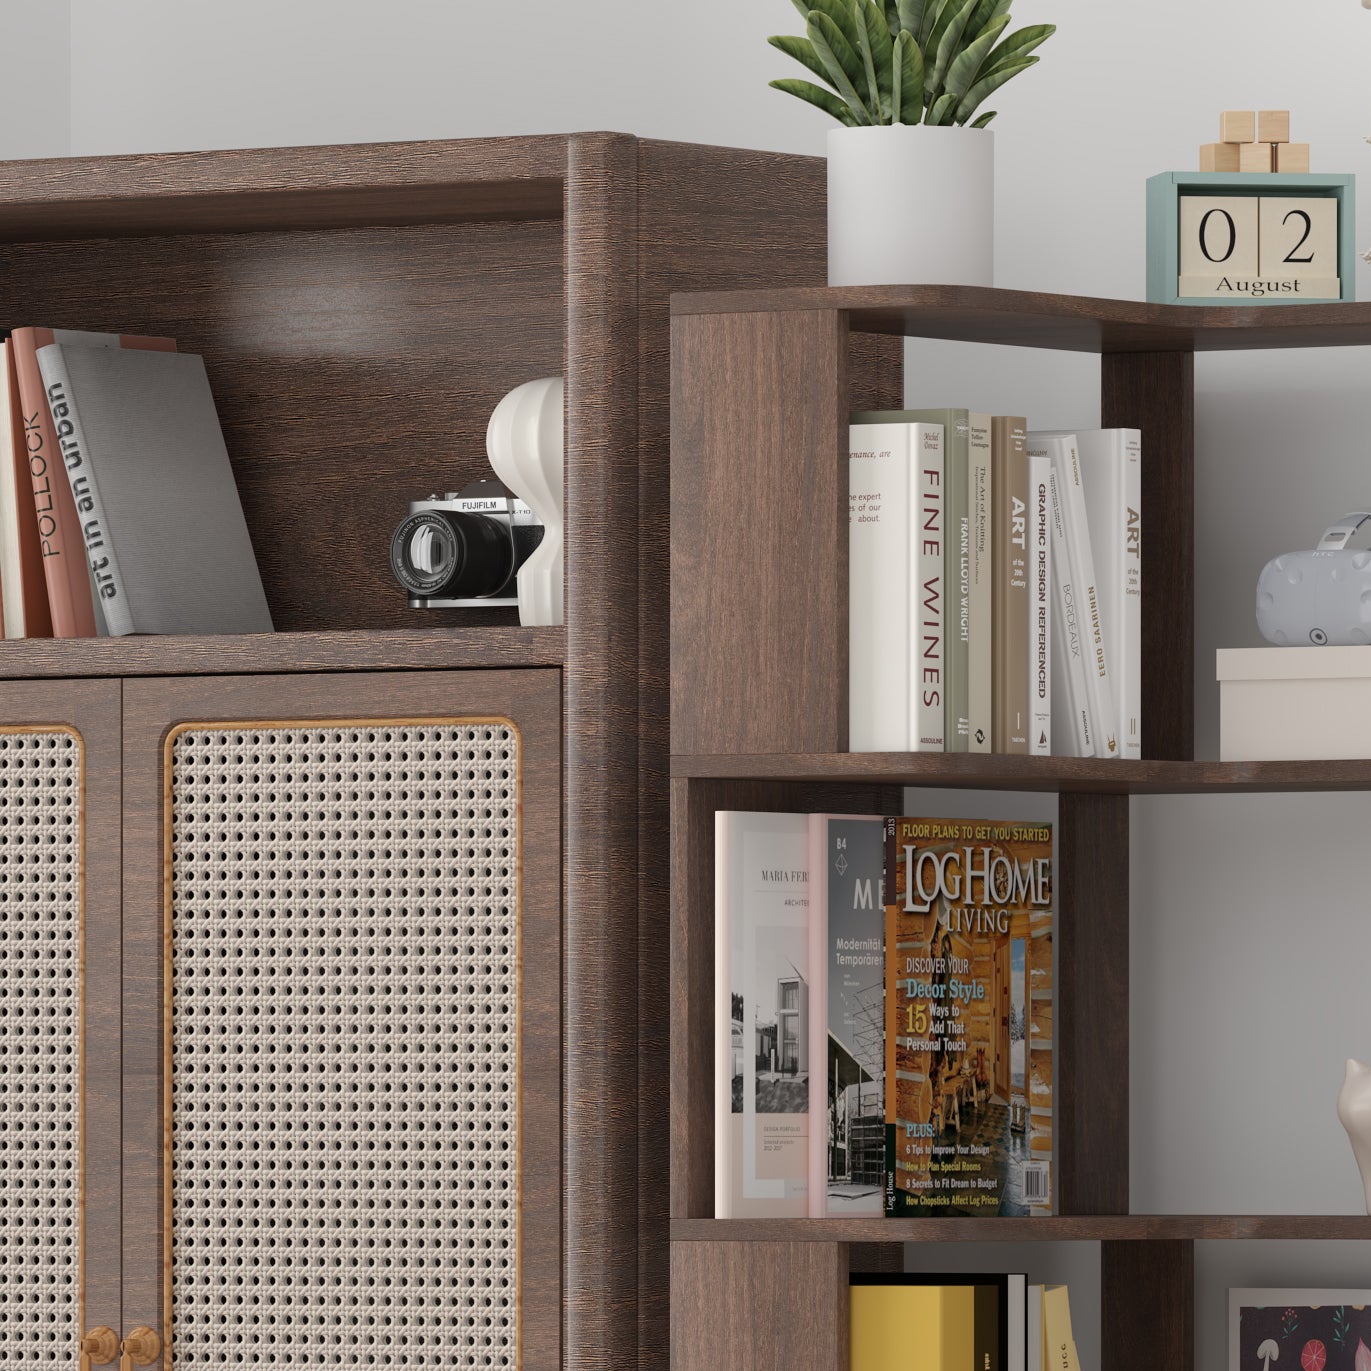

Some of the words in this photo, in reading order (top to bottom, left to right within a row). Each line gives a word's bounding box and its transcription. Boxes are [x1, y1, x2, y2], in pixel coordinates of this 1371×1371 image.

[1216, 276, 1301, 297] August
[48, 382, 83, 470] urban
[23, 411, 60, 557] POLLOCK
[72, 476, 94, 513] an
[462, 501, 497, 510] FUJIFILM
[858, 493, 881, 504] expert
[858, 503, 866, 512] of
[923, 469, 940, 556] FINE
[1012, 496, 1025, 550] ART
[1038, 484, 1046, 546] GRAPHIC
[84, 519, 104, 550] in
[961, 518, 969, 554] FRANK
[1127, 507, 1140, 558] ART
[92, 556, 117, 600] art
[961, 557, 969, 594] LLOYD
[1011, 579, 1025, 588] Century
[1038, 551, 1046, 602] DESIGN
[1126, 588, 1140, 597] Century
[961, 597, 969, 643] WRIGHT
[1063, 584, 1080, 659] BORDEAUX
[1088, 586, 1102, 644] SAARINEN
[923, 576, 940, 708] WINES
[1038, 607, 1046, 699] REFERENCED
[1096, 648, 1106, 677] EERO
[920, 737, 943, 745] ASSOULINE
[836, 838, 846, 849] B4
[903, 824, 929, 837] FLOOR
[933, 825, 959, 838] PLANS
[962, 826, 972, 839] TO
[976, 826, 991, 839] GET
[994, 827, 1011, 840] YOU
[1013, 828, 1049, 841] STARTED
[762, 870, 789, 882] MARIA
[947, 908, 1008, 934] LIVING
[836, 938, 880, 950] Modernität
[906, 957, 945, 974] DISCOVER
[948, 958, 969, 974] YOUR
[906, 979, 946, 998] Decor
[949, 979, 984, 1004] Style
[906, 1004, 927, 1033] 15
[929, 1003, 949, 1019] Ways
[952, 1005, 960, 1017] to
[929, 1021, 945, 1034] Add
[947, 1021, 964, 1034] That
[906, 1038, 941, 1051] Personal
[943, 1038, 966, 1051] Touch
[906, 1124, 935, 1138] PLUS:
[906, 1145, 911, 1155] 6
[912, 1145, 923, 1156] Tips
[925, 1145, 931, 1155] to
[932, 1145, 955, 1156] Improve
[957, 1145, 969, 1155] Your
[971, 1145, 990, 1156] Design
[906, 1162, 918, 1171] How
[920, 1162, 926, 1171] to
[928, 1162, 940, 1171] Plan
[941, 1162, 960, 1173] Special
[962, 1162, 981, 1171] Rooms
[886, 1171, 894, 1195] House
[912, 1179, 933, 1189] Secrets
[935, 1179, 941, 1188] to
[951, 1179, 969, 1188] Dream
[971, 1179, 976, 1188] to
[978, 1179, 998, 1190] Budget
[886, 1195, 896, 1210] Log
[906, 1196, 918, 1206] How
[920, 1196, 950, 1207] Chopsticks
[952, 1196, 968, 1206] Affect
[970, 1196, 980, 1207] Log
[981, 1197, 999, 1206] Prices
